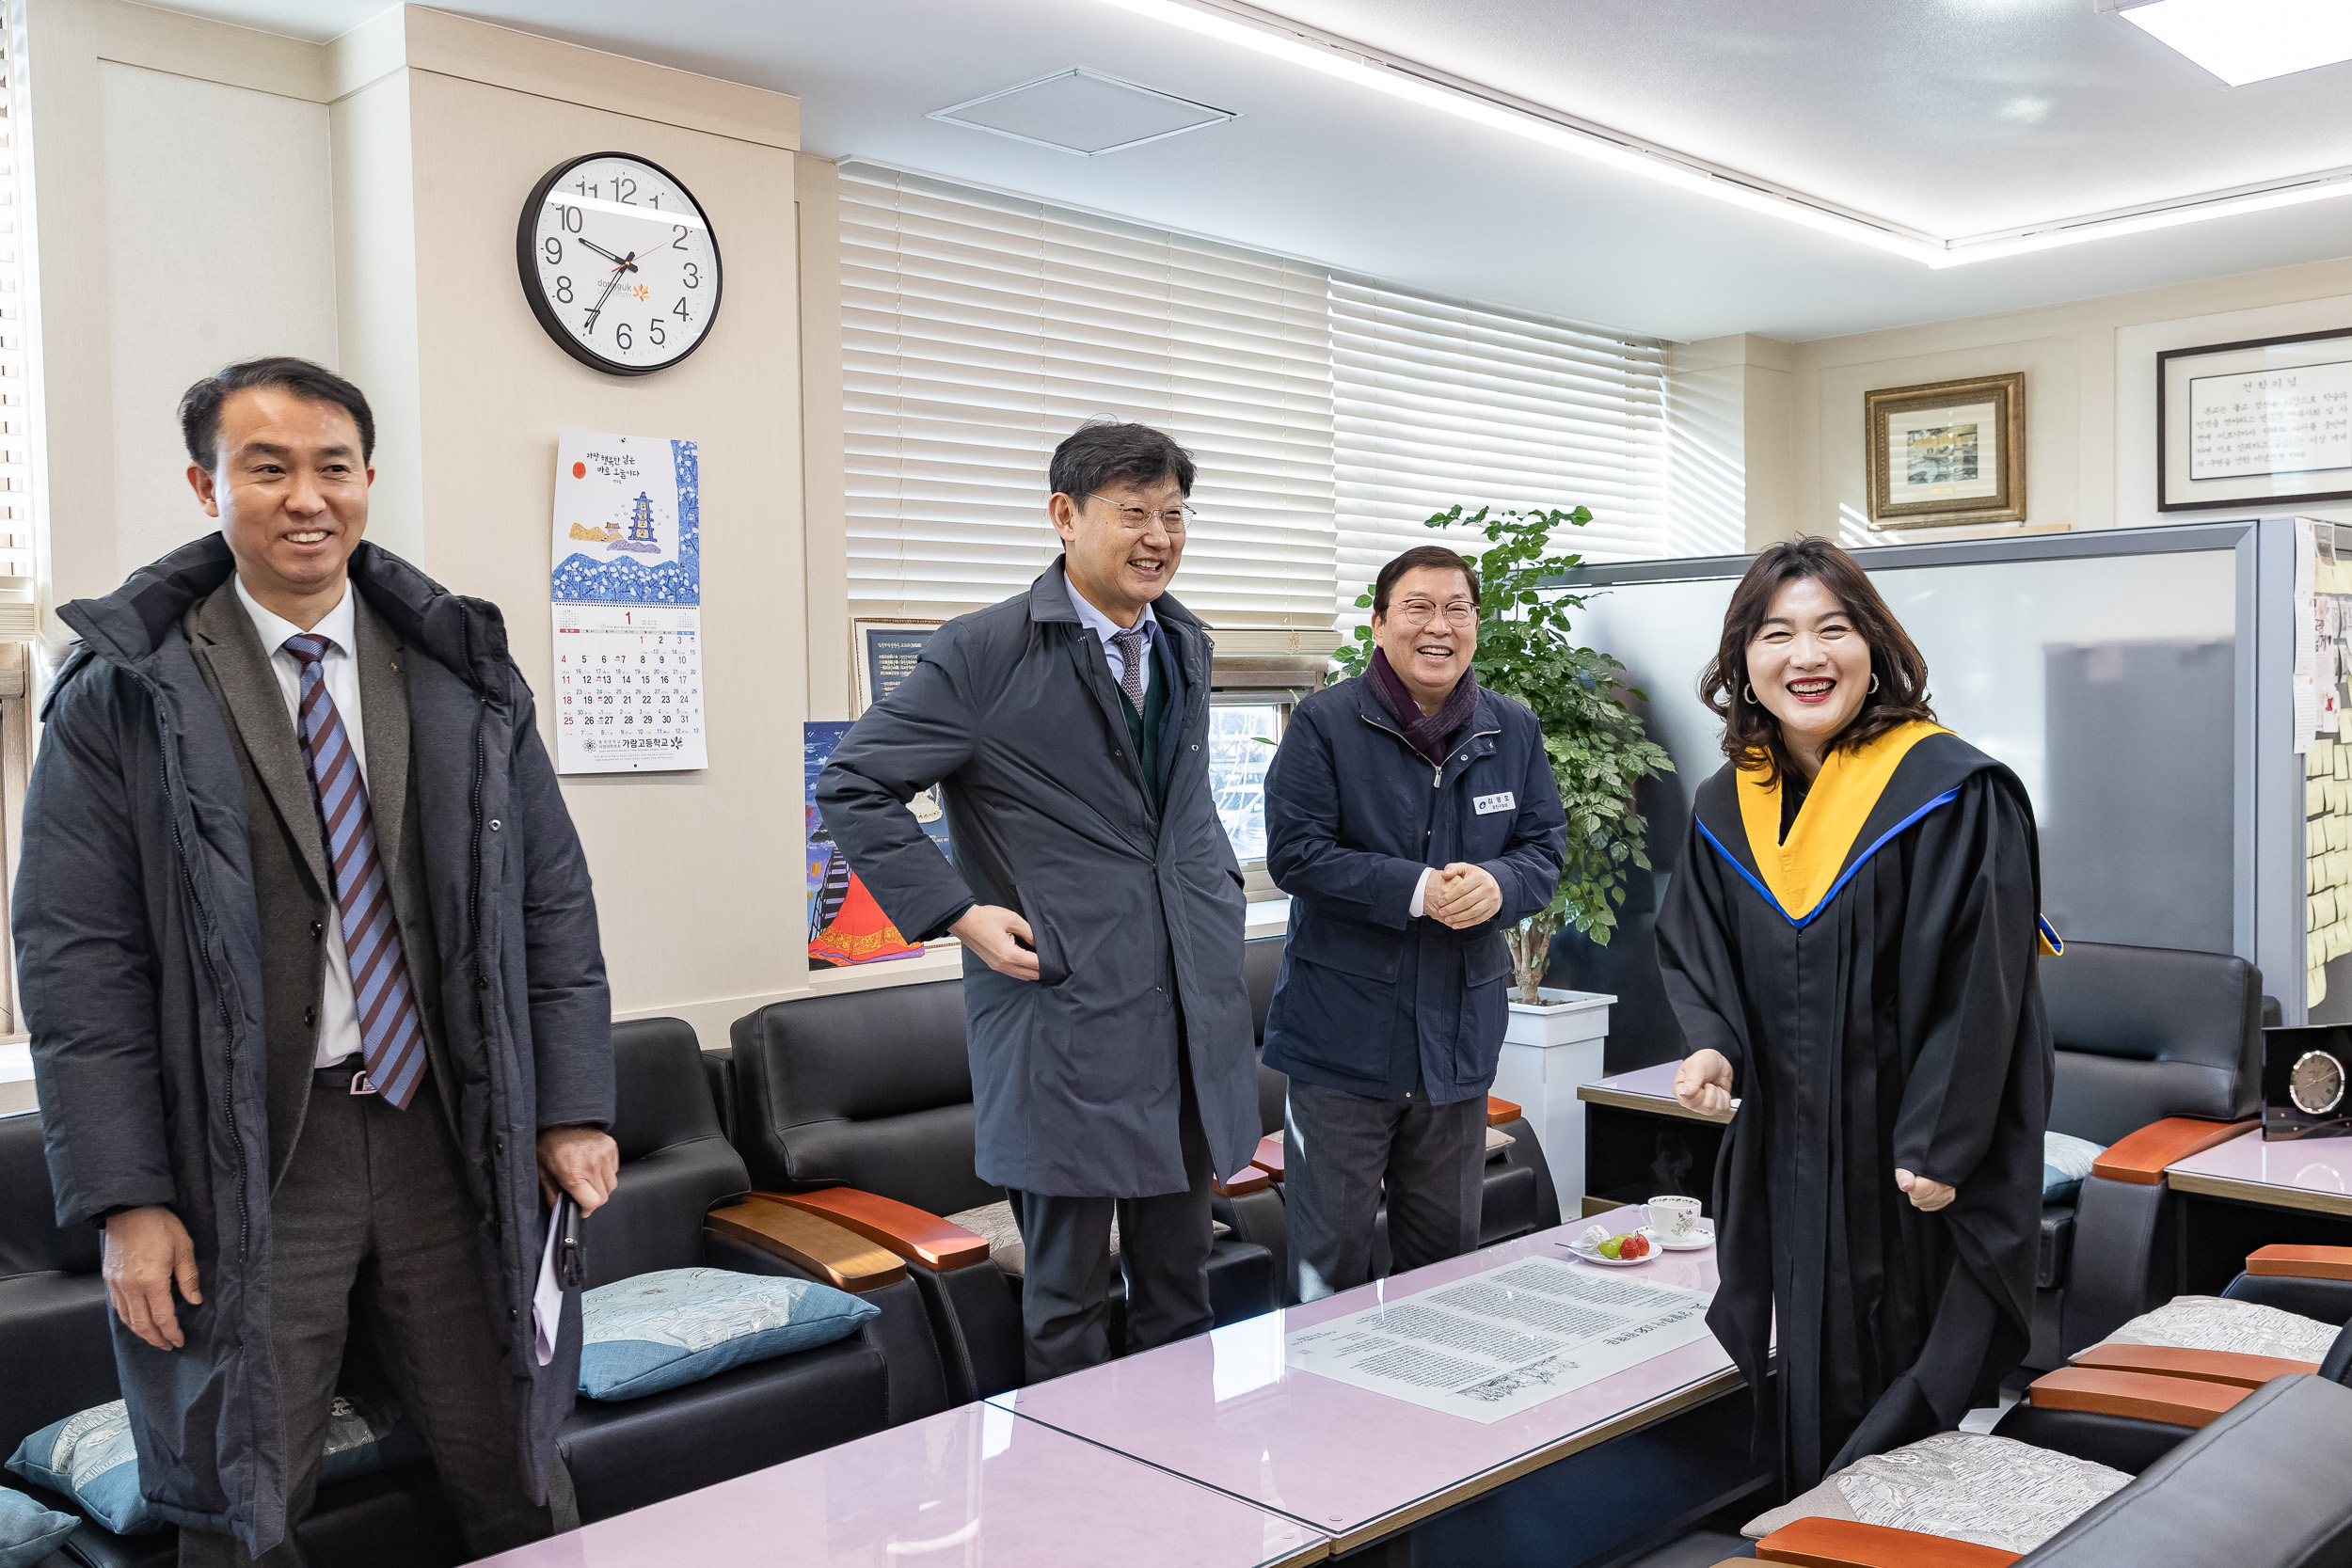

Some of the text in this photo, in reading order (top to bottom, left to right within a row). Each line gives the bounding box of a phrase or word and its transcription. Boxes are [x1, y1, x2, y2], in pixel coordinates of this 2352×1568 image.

[575, 181, 598, 199] 11
[610, 177, 637, 206] 12
[648, 195, 659, 210] 1
[555, 204, 583, 233] 10
[672, 224, 689, 251] 2
[545, 237, 563, 264] 9
[683, 262, 699, 289] 3
[556, 276, 574, 304] 8
[673, 296, 690, 322] 4
[584, 308, 601, 335] 7
[616, 323, 633, 350] 6
[649, 318, 666, 345] 5
[586, 451, 636, 467] 가장 행복한 날은
[596, 466, 640, 480] 바로 오늘이다
[625, 611, 631, 626] 1
[640, 636, 682, 644] 1 2 3
[561, 655, 566, 663] 4
[601, 655, 607, 663] 6
[678, 656, 687, 664] 10
[562, 675, 687, 684] 11 12 13 14 15 16 17
[563, 696, 572, 705] 18
[583, 696, 593, 705] 19
[603, 696, 613, 705] 20
[679, 695, 689, 704] 24
[564, 717, 574, 725] 25
[584, 716, 595, 725] 26
[604, 716, 613, 724] 27
[624, 716, 633, 724] 28
[662, 715, 672, 723] 30
[680, 715, 689, 723] 31
[622, 737, 669, 748] 가람고등학교
